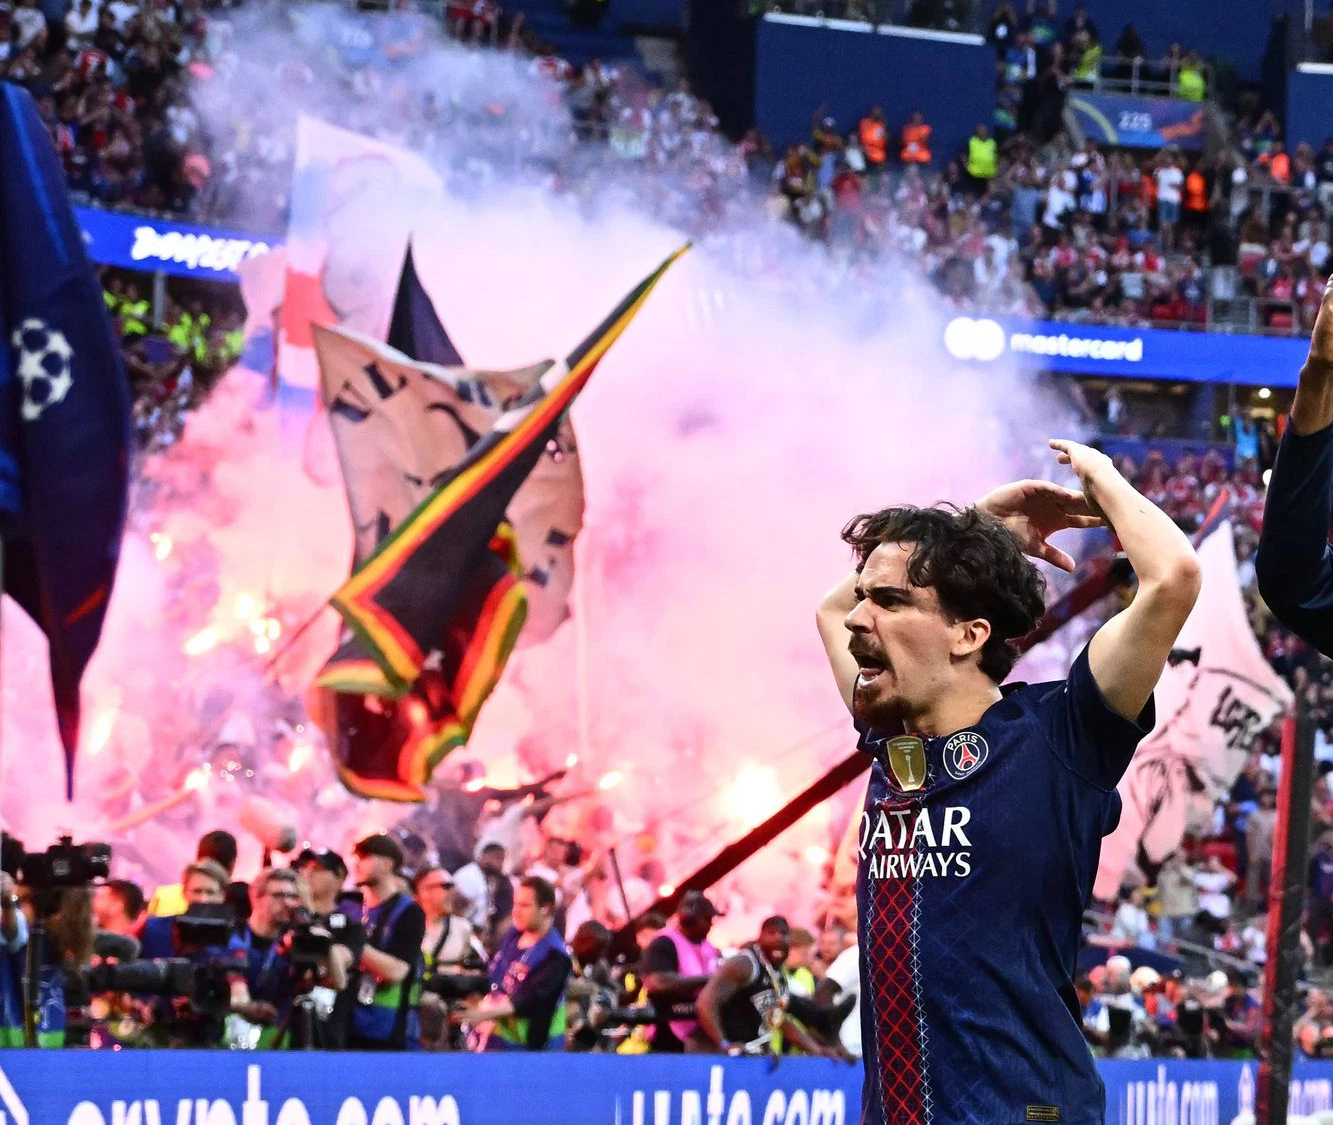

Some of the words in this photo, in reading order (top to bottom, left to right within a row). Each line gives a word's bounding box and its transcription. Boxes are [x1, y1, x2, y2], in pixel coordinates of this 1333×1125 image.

[1010, 333, 1142, 361] mastercard
[947, 734, 978, 751] PARIS
[868, 852, 971, 880] AIRWAYS
